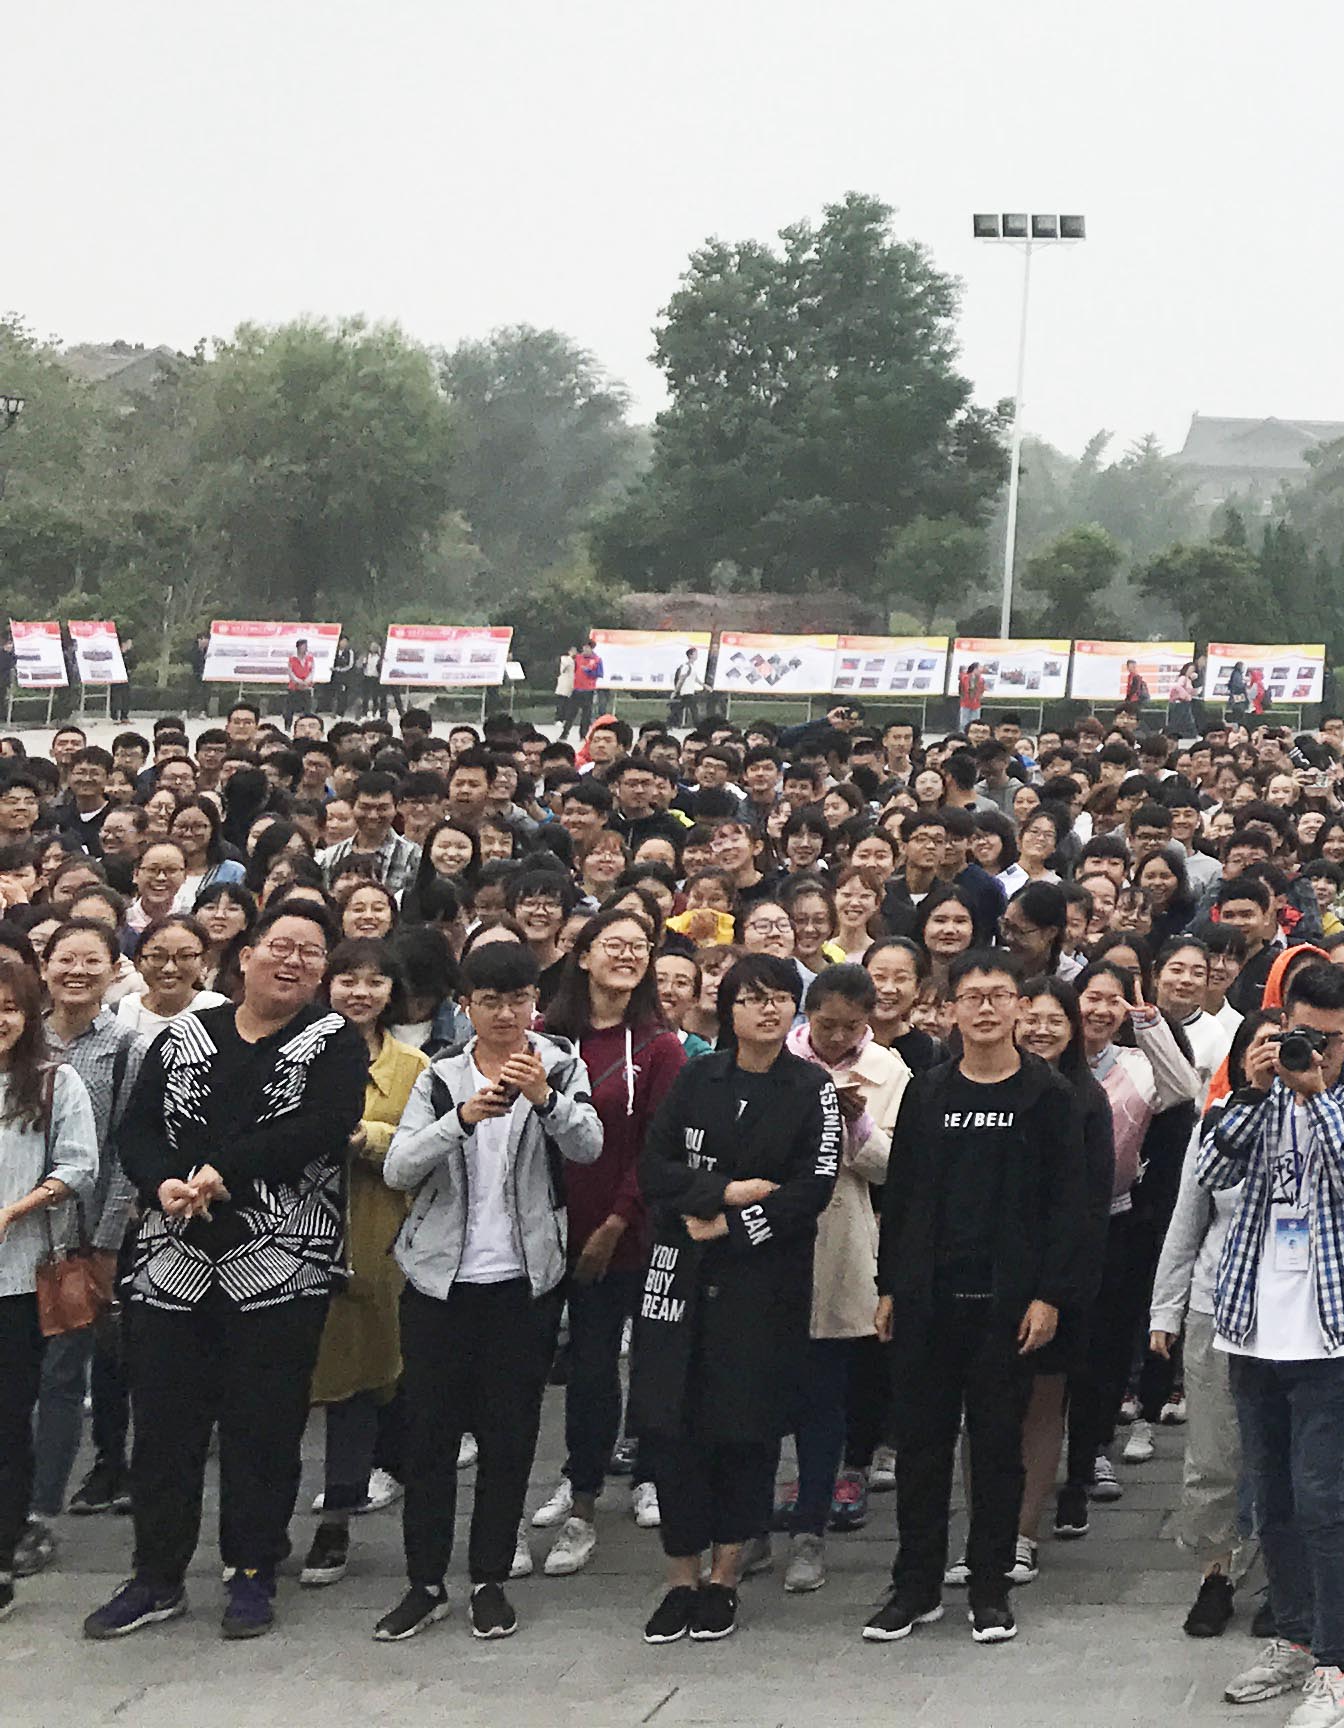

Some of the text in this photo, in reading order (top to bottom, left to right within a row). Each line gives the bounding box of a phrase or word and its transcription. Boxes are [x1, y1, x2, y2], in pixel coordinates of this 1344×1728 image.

[740, 1204, 774, 1246] CAN
[651, 1244, 679, 1271] YOU
[645, 1268, 675, 1296] BUY
